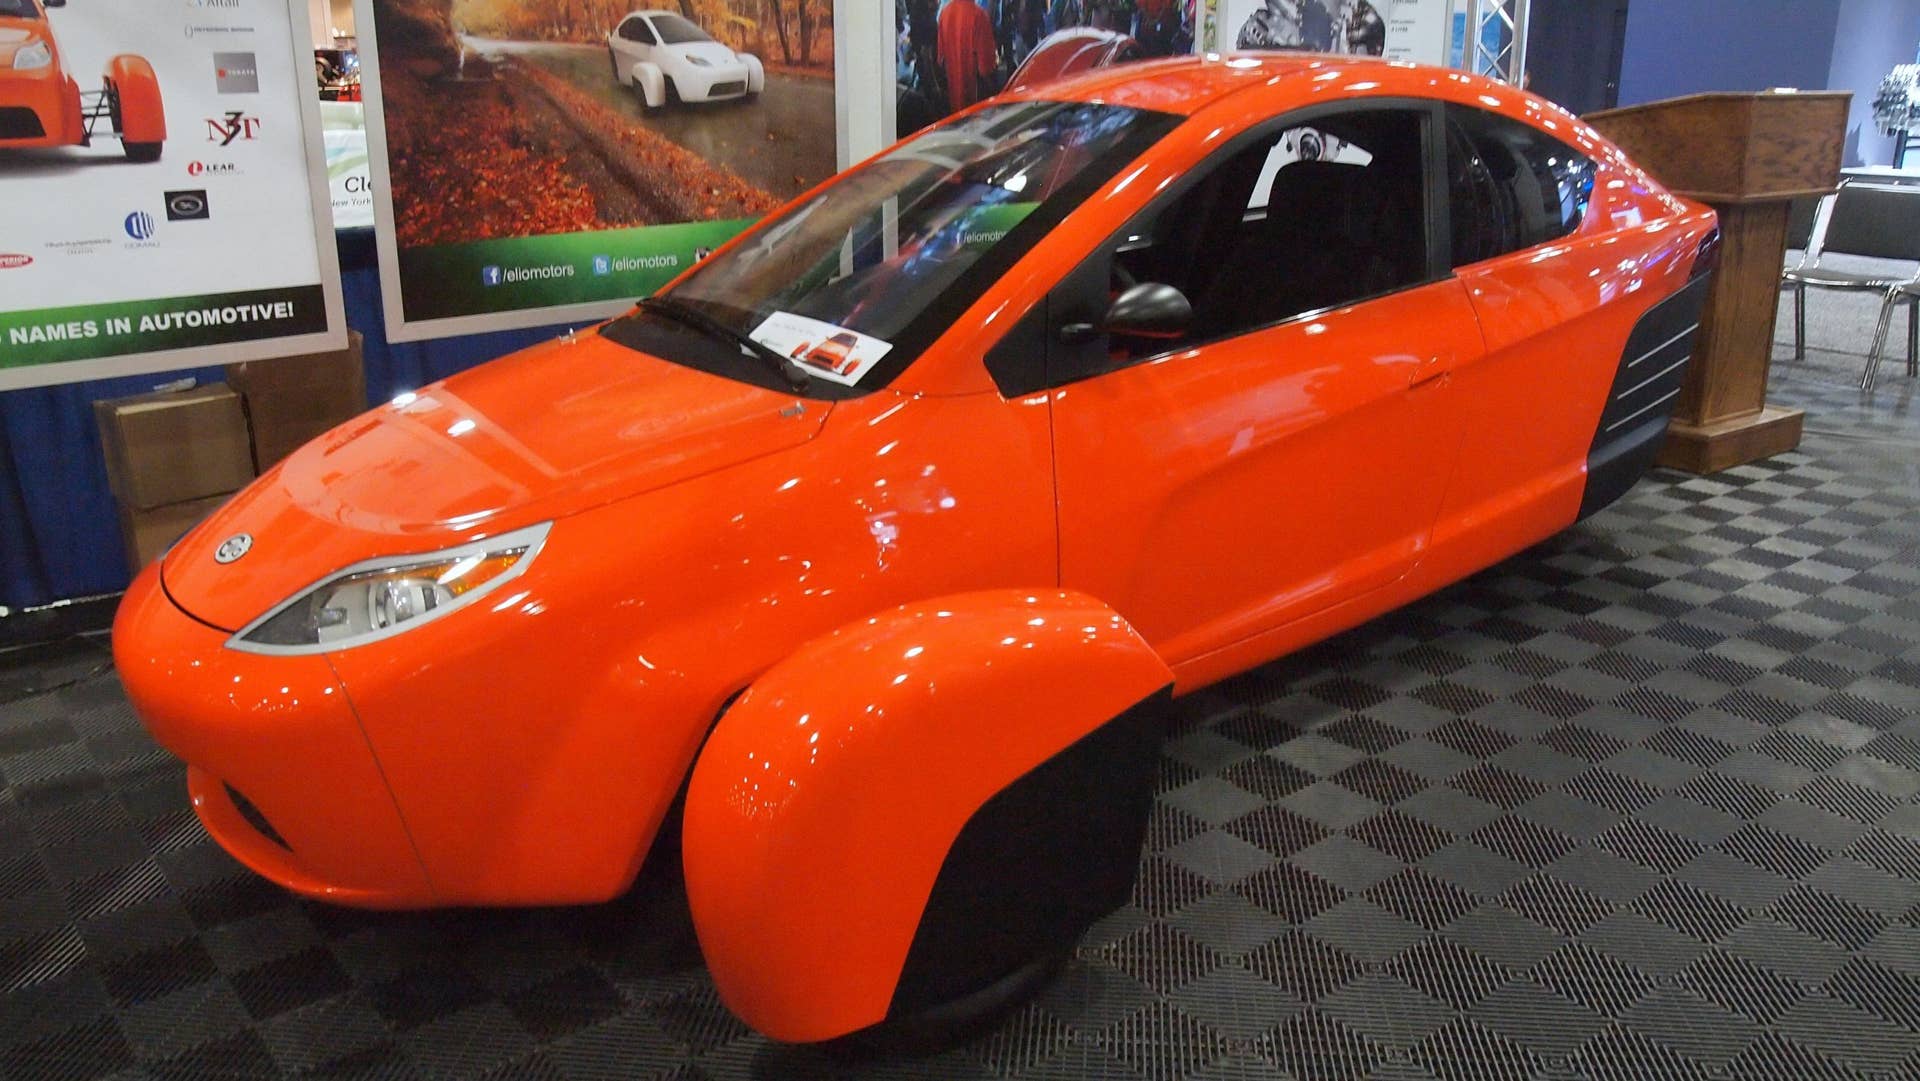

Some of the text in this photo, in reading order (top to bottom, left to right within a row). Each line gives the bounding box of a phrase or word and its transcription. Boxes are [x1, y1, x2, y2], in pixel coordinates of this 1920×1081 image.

[206, 163, 234, 172] LEAR
[611, 254, 677, 271] /eliomotors
[503, 264, 574, 283] /eliomotors
[9, 301, 294, 345] NAMES IN AUTOMOTIVE!
